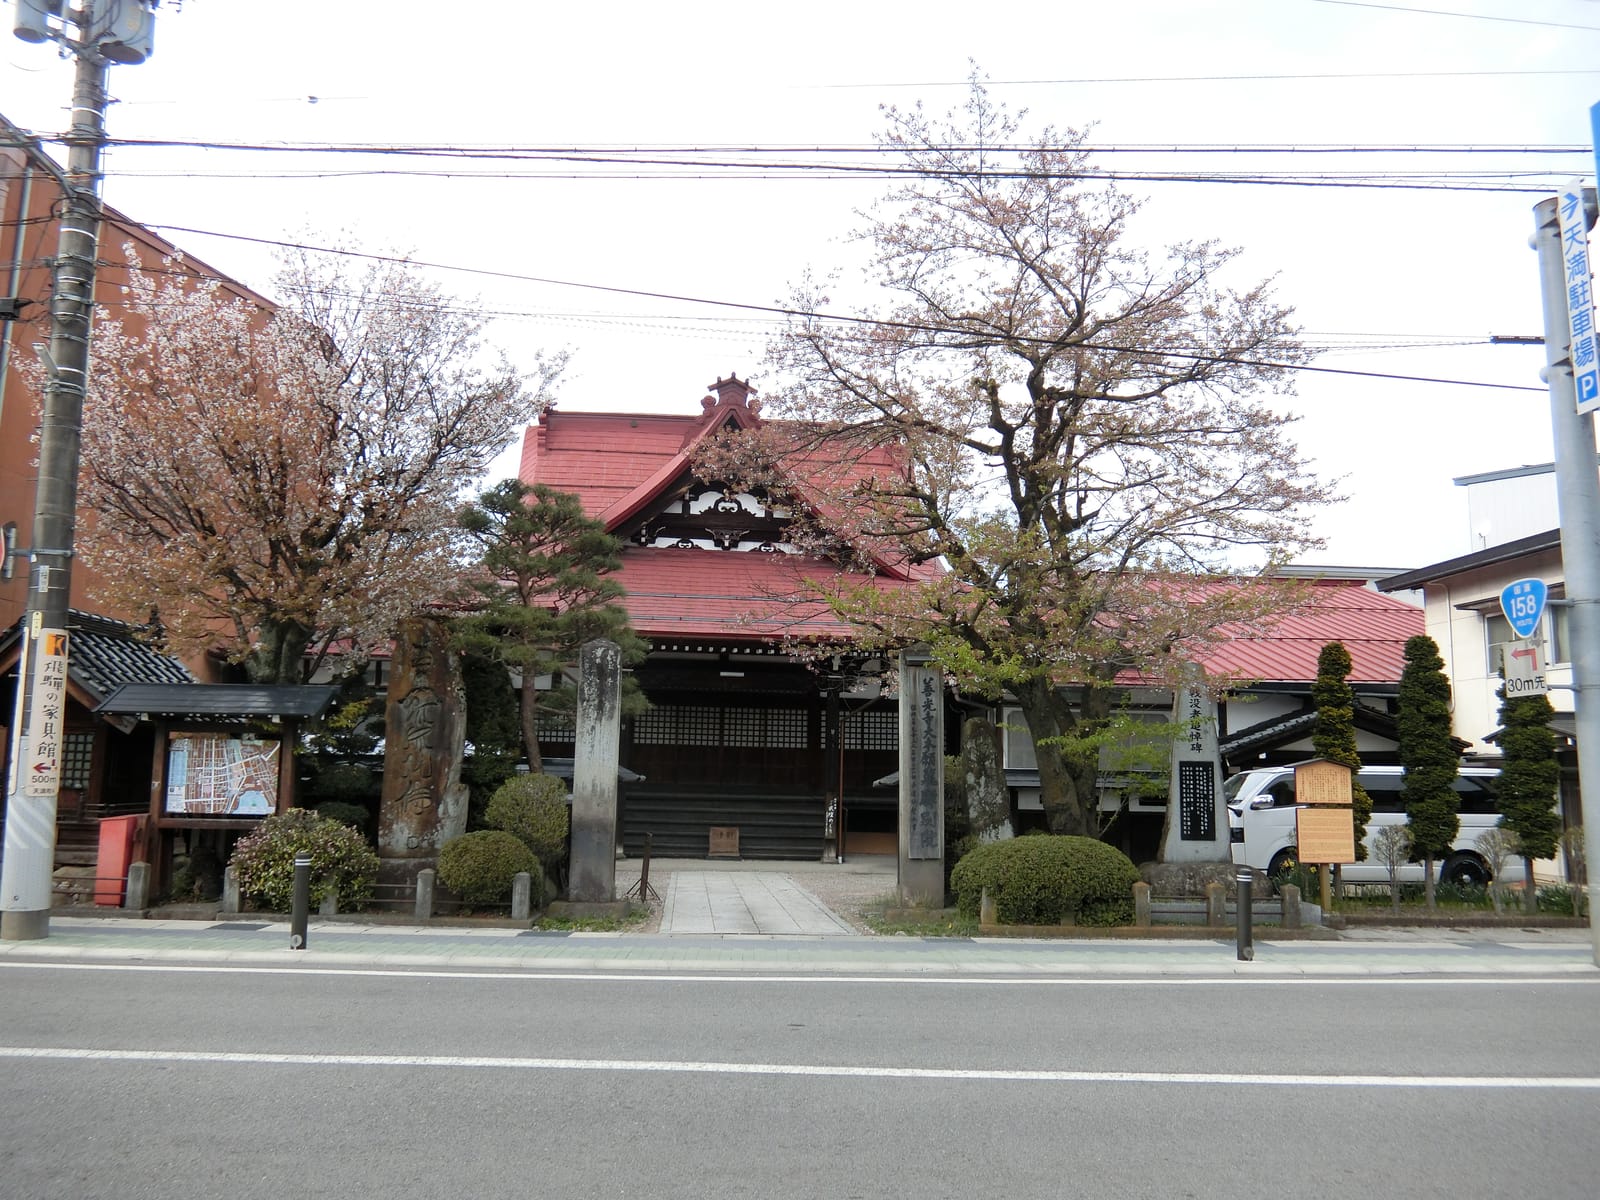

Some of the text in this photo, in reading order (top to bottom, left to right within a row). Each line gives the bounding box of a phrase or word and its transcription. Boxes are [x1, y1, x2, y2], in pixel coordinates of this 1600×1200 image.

[1563, 219, 1596, 368] 天満駐車場
[1510, 594, 1537, 619] 158
[1507, 675, 1546, 693] 30m先
[31, 774, 57, 784] 500m
